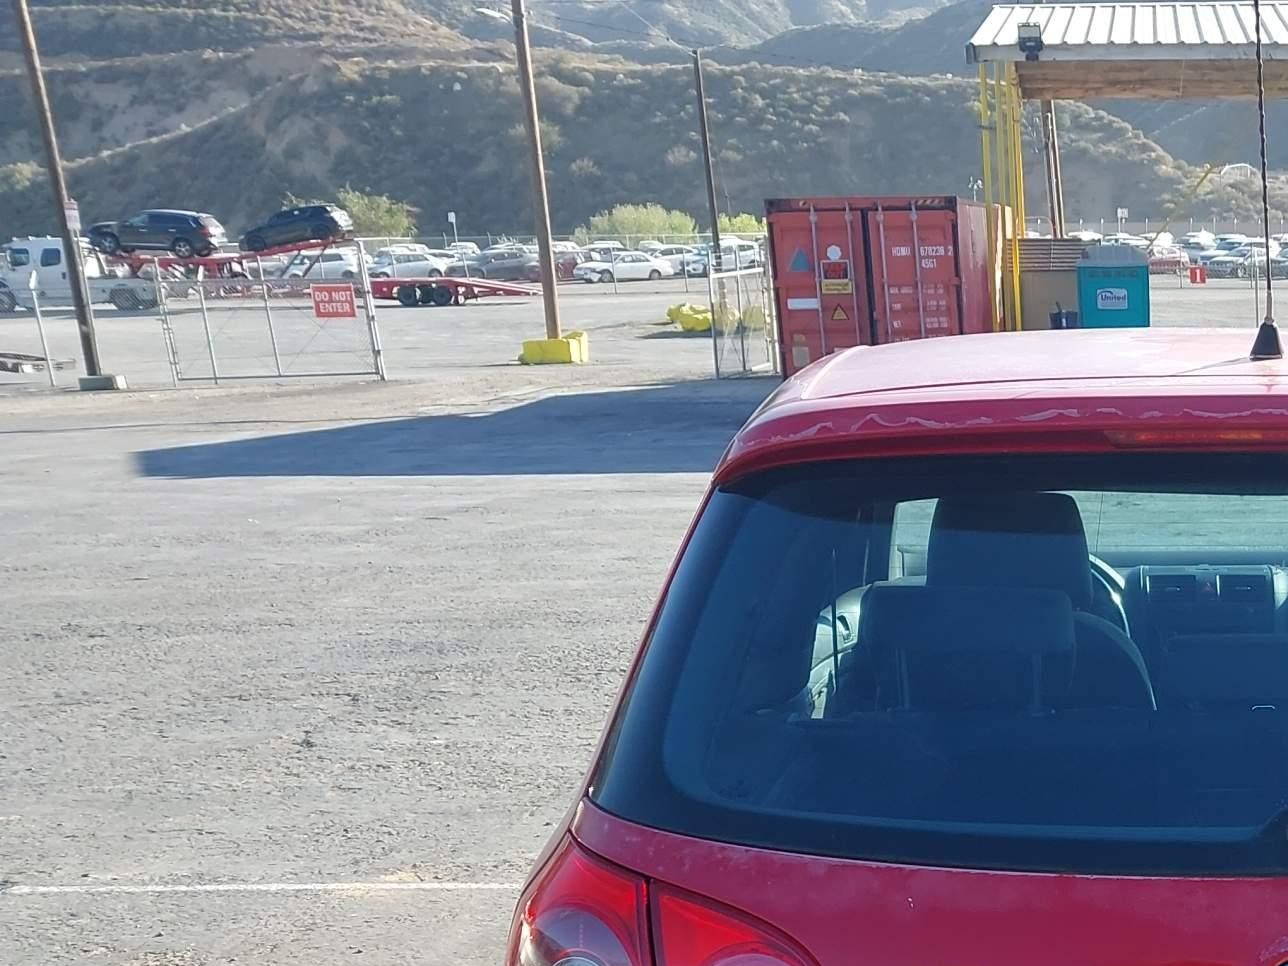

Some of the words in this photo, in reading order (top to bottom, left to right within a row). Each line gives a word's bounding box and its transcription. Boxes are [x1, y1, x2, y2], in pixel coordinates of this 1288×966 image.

[1195, 269, 1201, 282] 1
[315, 291, 329, 301] DO
[331, 291, 351, 301] NOT
[1101, 294, 1126, 302] United
[320, 302, 351, 312] ENTER
